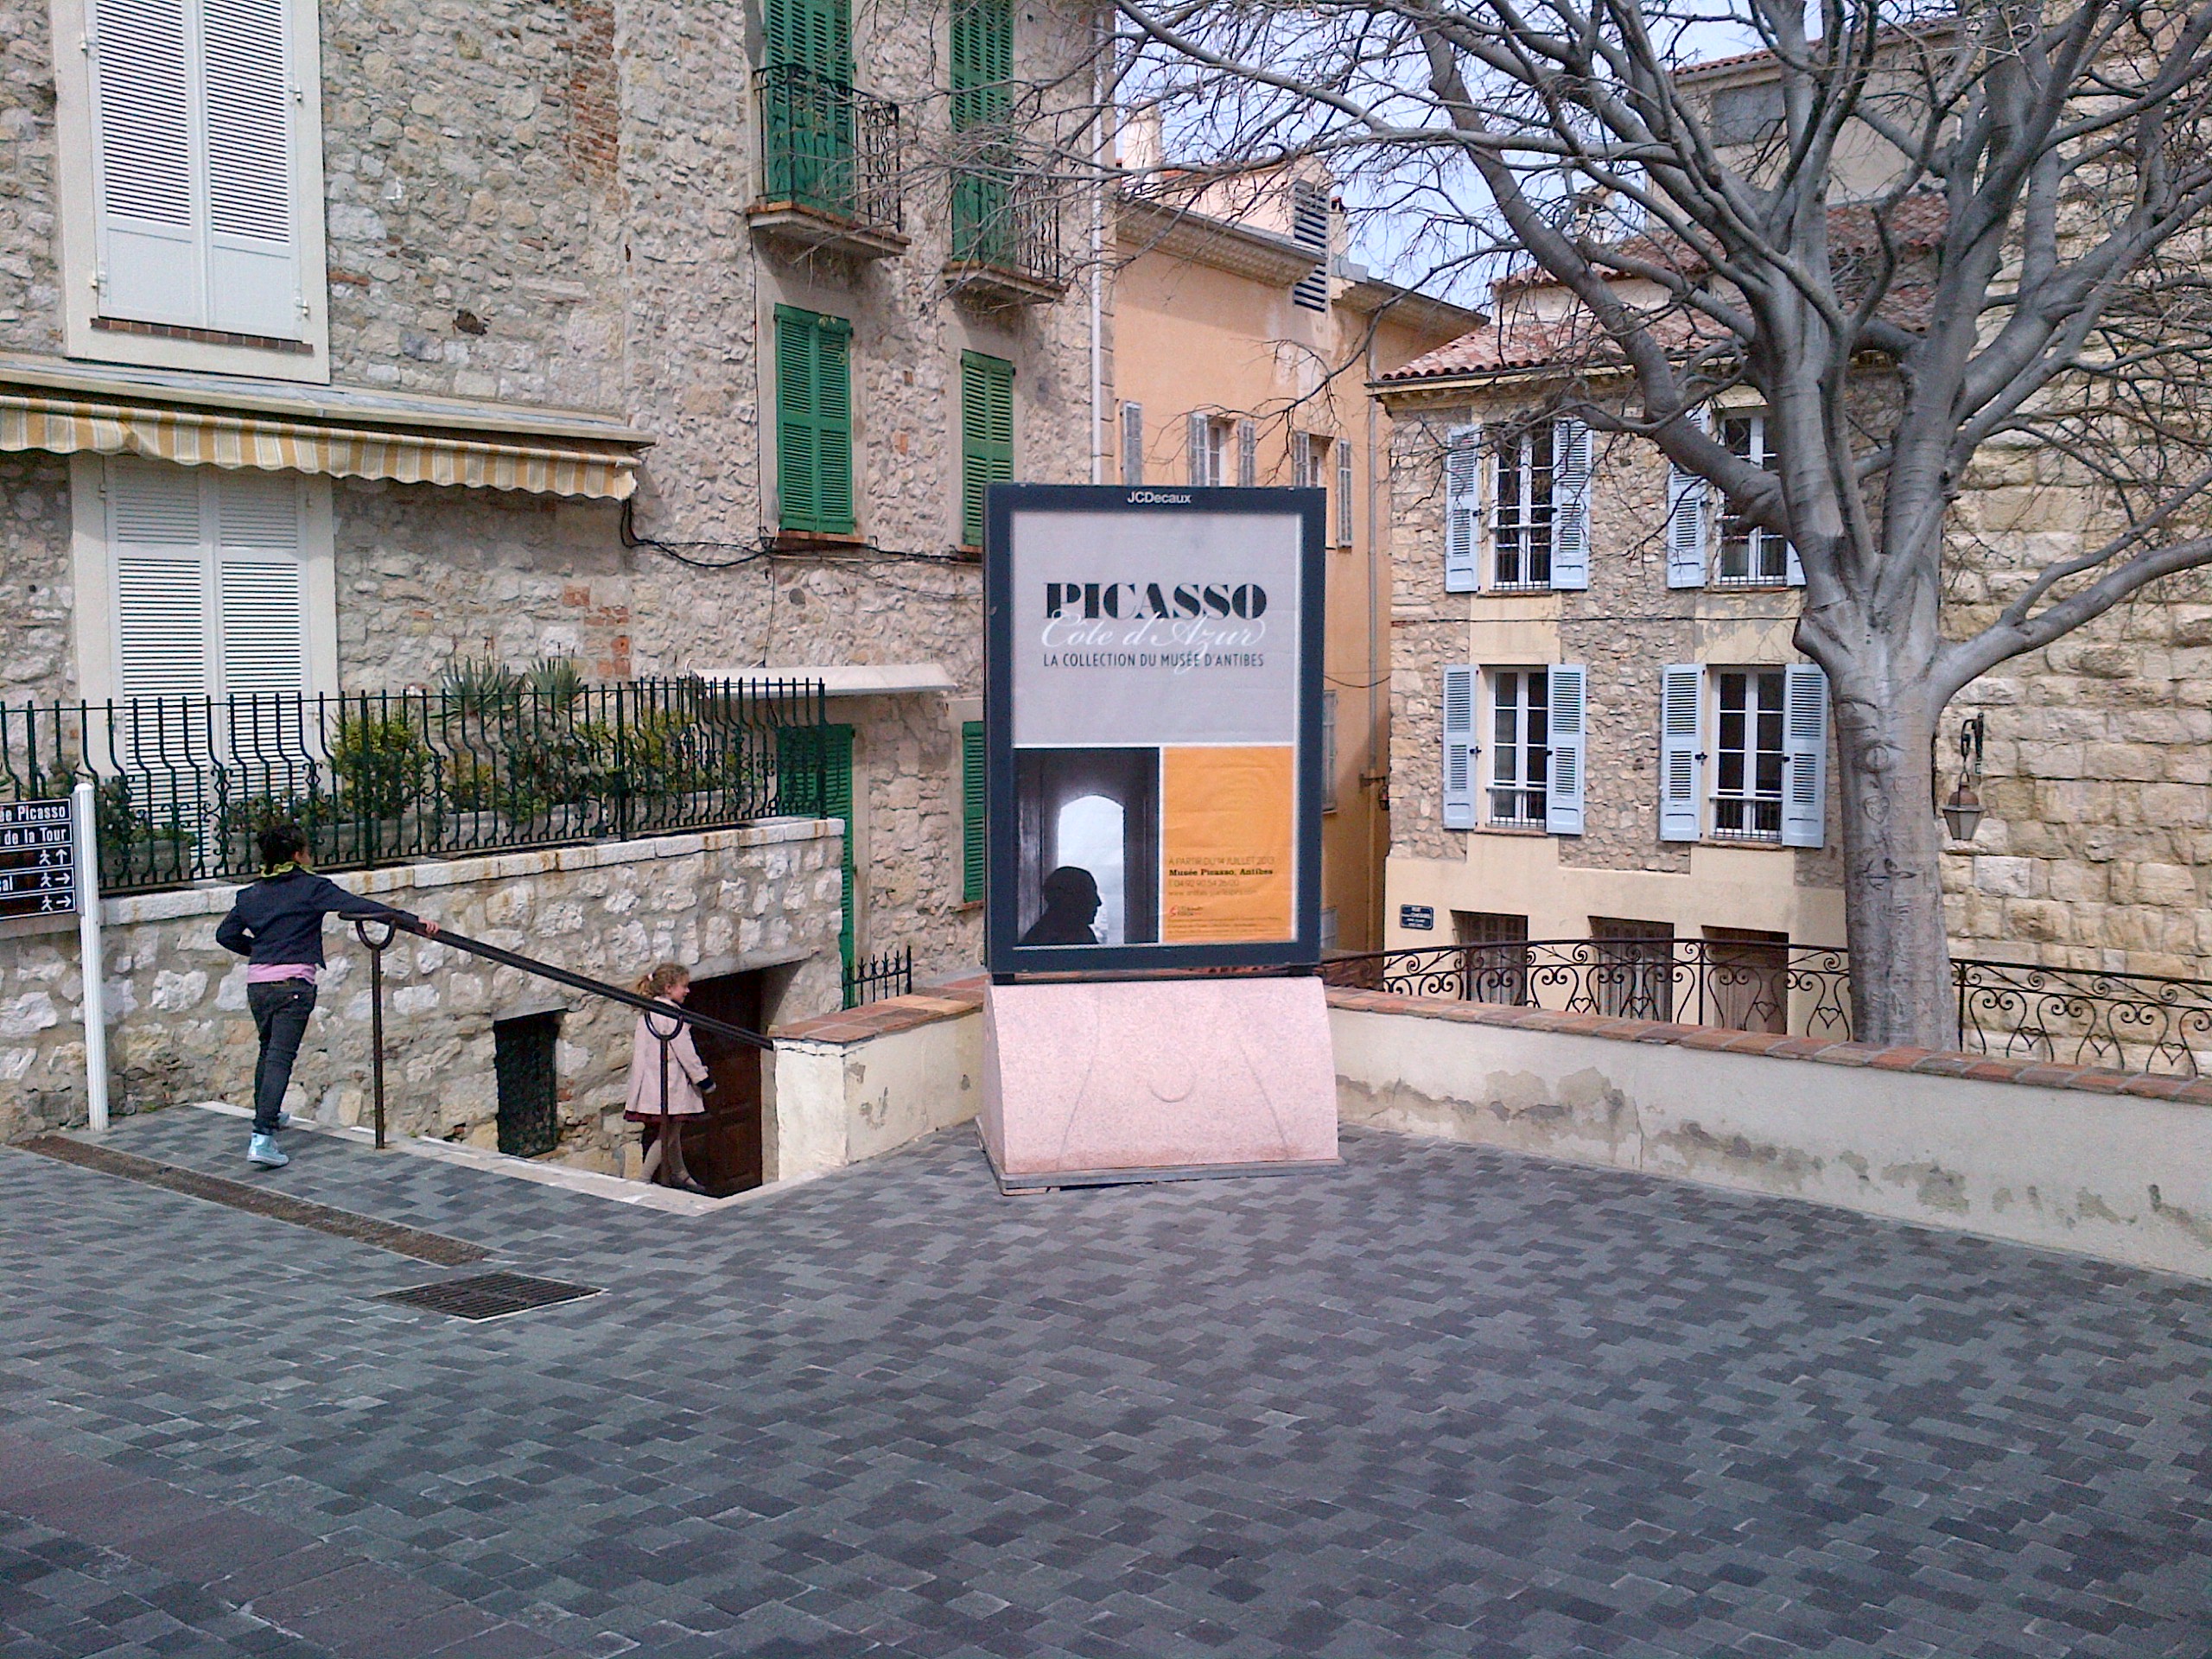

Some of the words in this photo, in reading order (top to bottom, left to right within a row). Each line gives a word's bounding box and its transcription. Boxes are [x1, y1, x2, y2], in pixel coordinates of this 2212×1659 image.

[1127, 491, 1192, 504] JCDecaux
[1043, 582, 1268, 620] PICASSO
[1041, 609, 1114, 647] Côte
[1122, 611, 1266, 674] d'Azur
[1043, 653, 1058, 667] LA
[1063, 653, 1135, 667] COLLECTION
[1141, 653, 1156, 667] DU
[1160, 651, 1200, 667] MUSÉE
[1205, 653, 1264, 667] D'ANTIBES
[17, 805, 66, 821] Picasso
[4, 830, 19, 846] de
[24, 829, 35, 844] la
[40, 827, 67, 842] Tour
[1204, 856, 1216, 866] DU
[1226, 855, 1255, 866] JUILLET
[1239, 868, 1274, 876] Antibes
[0, 876, 14, 892] al
